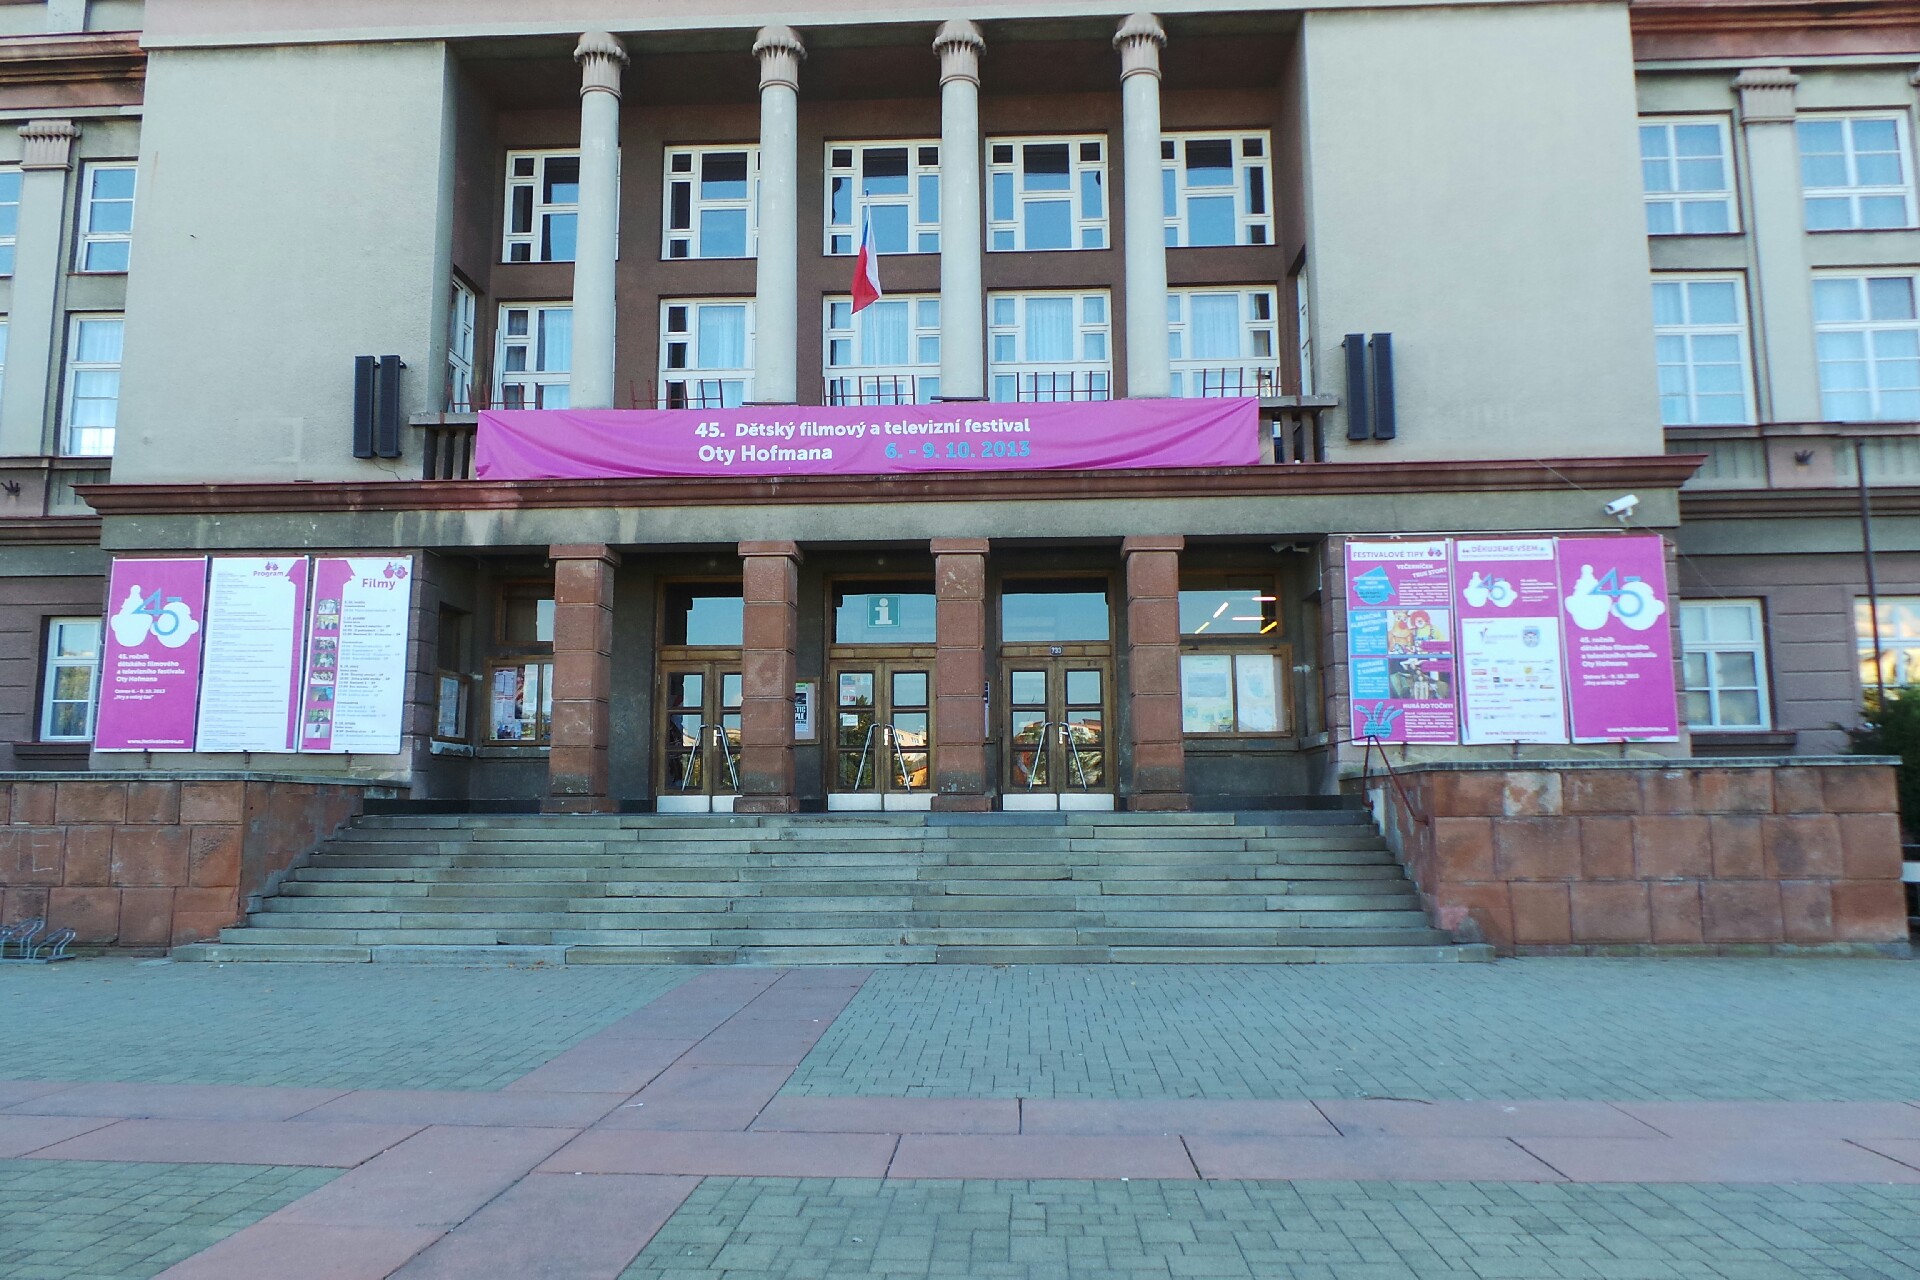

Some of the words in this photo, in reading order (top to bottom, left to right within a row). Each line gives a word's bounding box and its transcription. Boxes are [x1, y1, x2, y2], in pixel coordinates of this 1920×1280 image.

[694, 421, 725, 438] 45.
[735, 421, 796, 440] Dětský
[800, 421, 867, 438] filmový
[870, 423, 880, 435] a
[884, 418, 960, 435] televizní
[964, 418, 1031, 433] festival
[698, 445, 736, 466] Oty
[741, 445, 833, 462] Hofmana
[884, 442, 903, 459] 6.
[922, 442, 940, 459] 9.
[946, 441, 976, 458] 10.
[981, 440, 1031, 458] 2013
[1353, 550, 1404, 558] FESTIVALOVÉ
[1471, 544, 1514, 553] DĚKUJEME
[1517, 543, 1538, 551] VŠEM
[362, 578, 396, 590] Filmy
